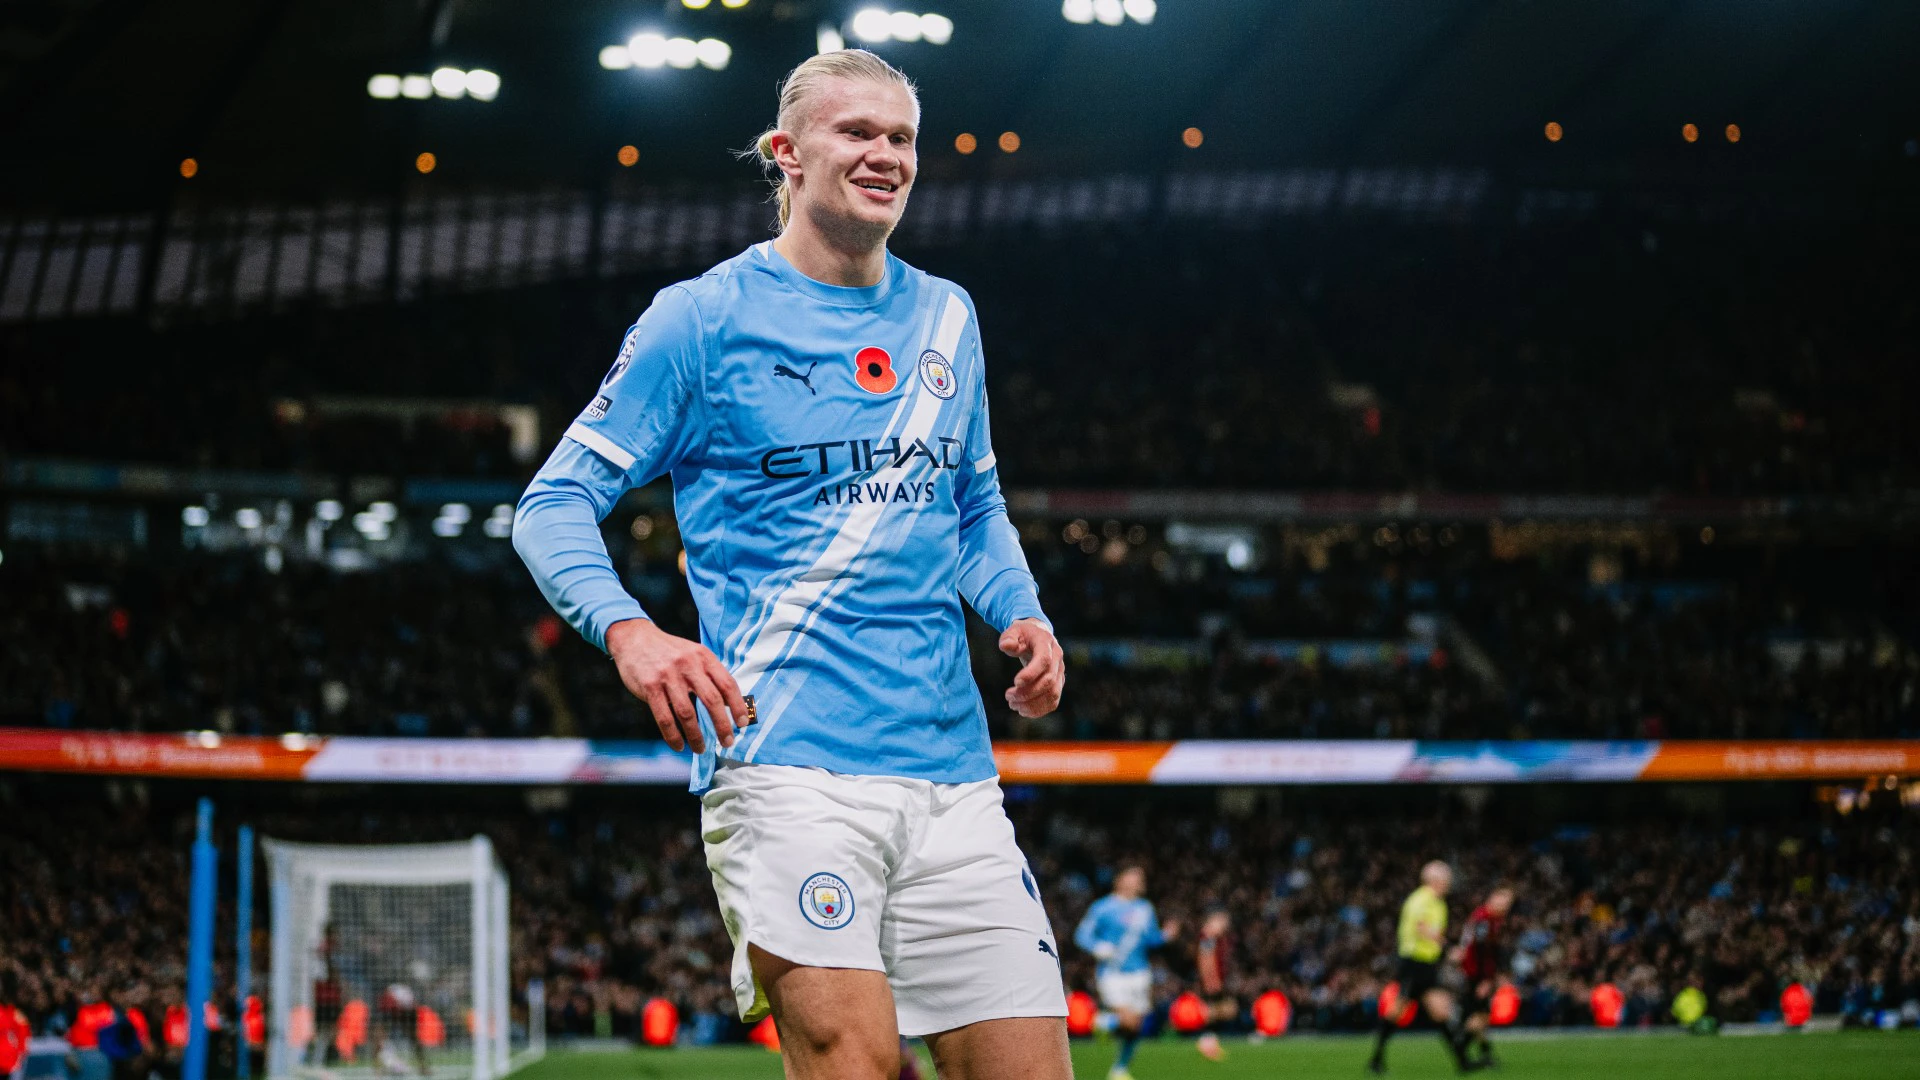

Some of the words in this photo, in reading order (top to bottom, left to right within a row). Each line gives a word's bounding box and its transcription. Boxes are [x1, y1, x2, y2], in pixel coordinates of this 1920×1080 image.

[760, 437, 964, 479] ETIHAD
[813, 481, 935, 506] AIRWAYS
[805, 877, 847, 895] MANCHESTER
